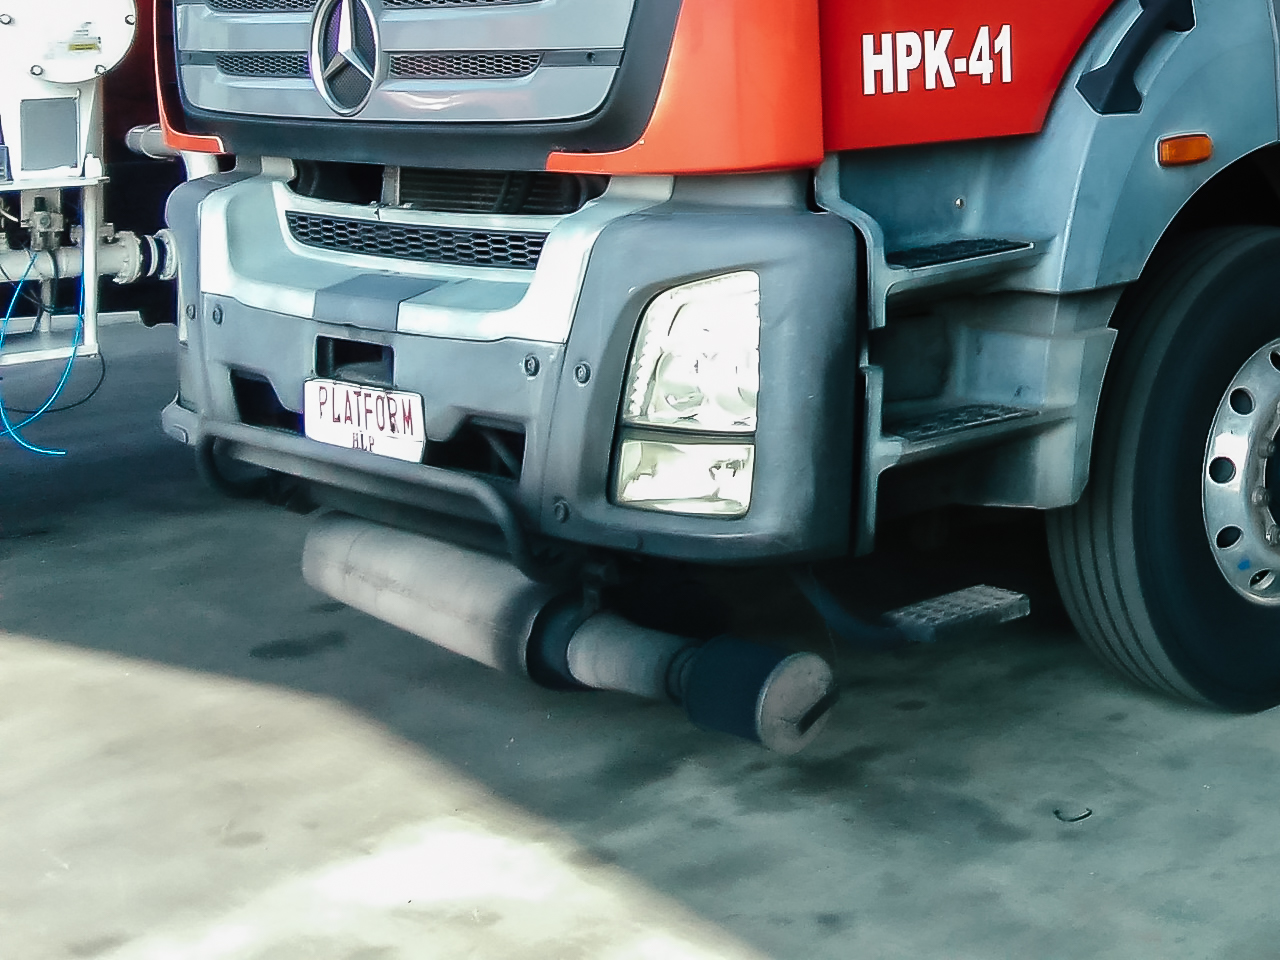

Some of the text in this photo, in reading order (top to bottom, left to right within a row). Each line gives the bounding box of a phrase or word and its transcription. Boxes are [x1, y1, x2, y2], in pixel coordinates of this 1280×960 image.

[862, 24, 1012, 96] HPK-41
[318, 385, 414, 436] PLATFORM
[352, 432, 375, 453] HLP
